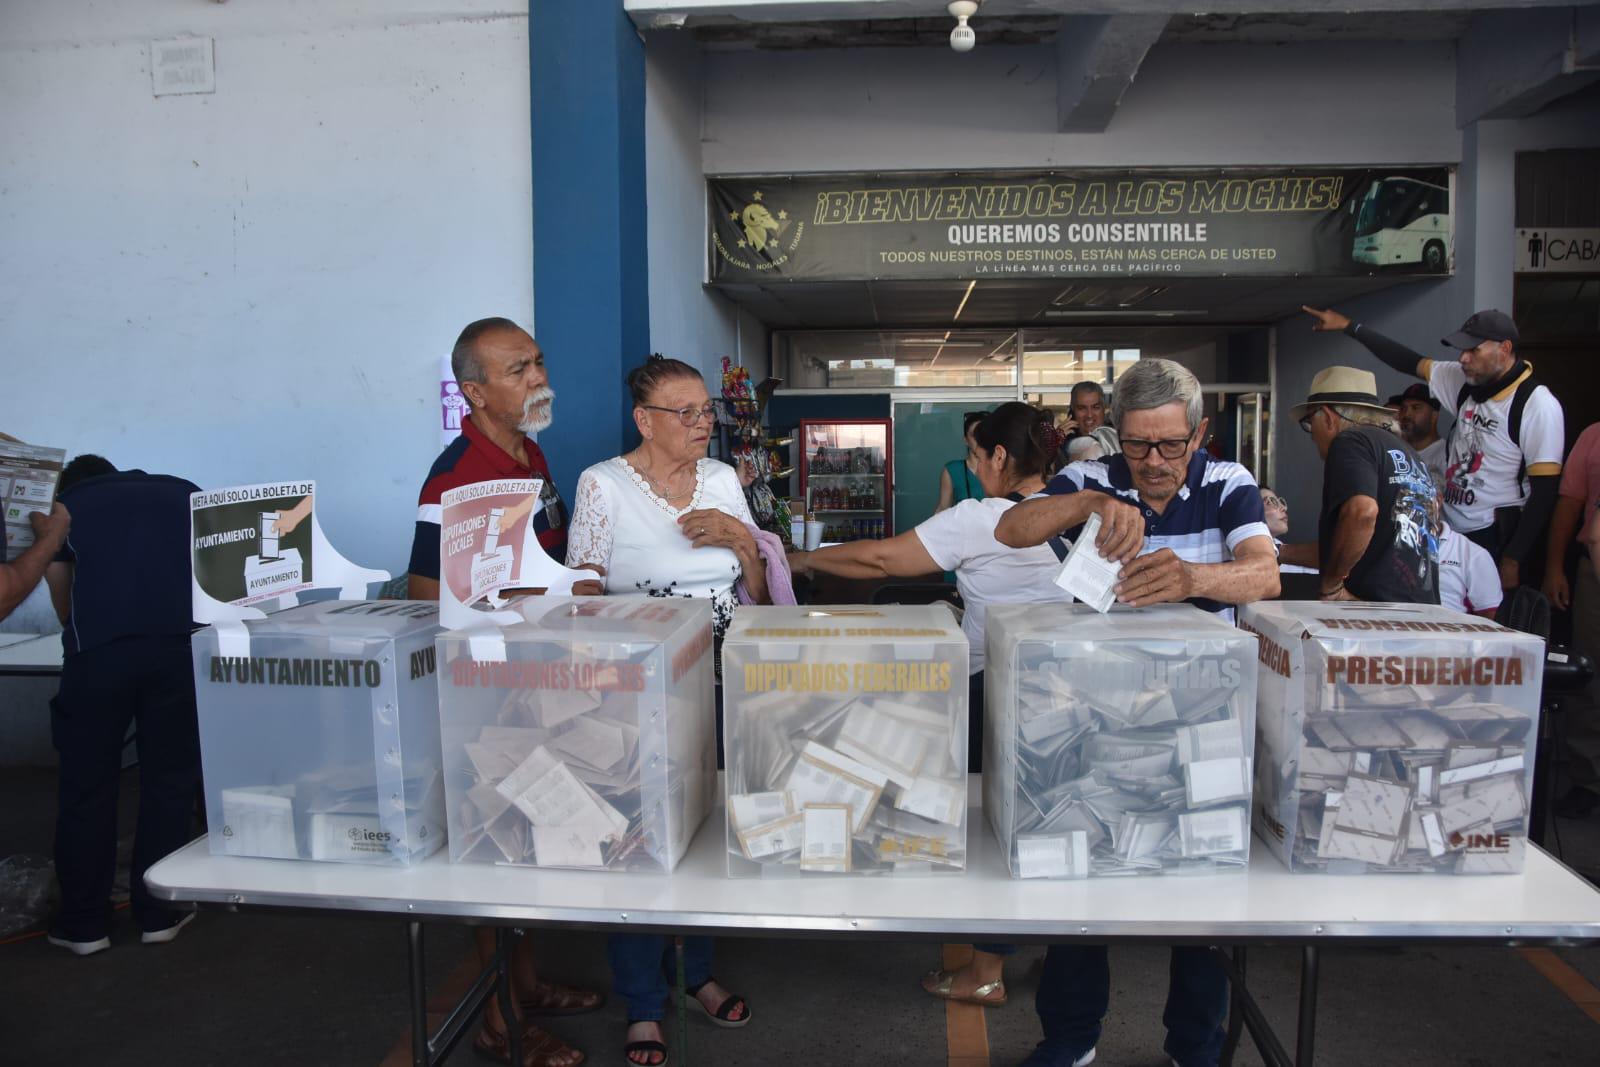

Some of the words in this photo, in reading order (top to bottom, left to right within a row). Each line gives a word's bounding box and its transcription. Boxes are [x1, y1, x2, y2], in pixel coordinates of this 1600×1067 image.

[813, 183, 1077, 225] ¡BIENVENIDOS
[1078, 182, 1107, 216] A
[1112, 181, 1186, 215] LOS
[1188, 176, 1344, 214] MOCHIS!
[947, 223, 1061, 246] QUEREMOS
[1067, 222, 1207, 243] CONSENTIRLE
[879, 250, 926, 263] TODOS
[929, 249, 1002, 262] NUESTROS
[1006, 248, 1077, 262] DESTINOS,
[1081, 246, 1123, 261] ESTÁN
[1128, 246, 1157, 261] MÁS
[1160, 248, 1207, 260] CERCA
[1210, 248, 1229, 260] DE
[1232, 247, 1277, 260] USTED
[975, 265, 989, 273] LA
[1060, 264, 1097, 272] CERCA
[1103, 264, 1123, 272] DEL
[192, 494, 208, 507] META
[209, 489, 226, 505] AQUÍ
[227, 489, 249, 502] SOLO
[250, 488, 261, 499] LA
[263, 485, 298, 498] BOLETA
[300, 483, 313, 494] DE
[469, 486, 486, 498] SOLO
[485, 485, 495, 495] LA
[496, 482, 526, 493] BOLETA
[527, 482, 540, 492] DE
[194, 527, 256, 550] AYUNTAMIENTO
[448, 533, 474, 557] LOCALES
[250, 570, 299, 590] AYUNTAMIENTO
[209, 655, 382, 688] AYUNTAMIENTO
[410, 645, 437, 681] AYU
[1326, 655, 1524, 686] PRESIDENCIA
[744, 662, 848, 693] DIPUTADOS
[853, 662, 951, 693] FEDERALES
[363, 828, 391, 842] iees
[1467, 833, 1510, 849] INE
